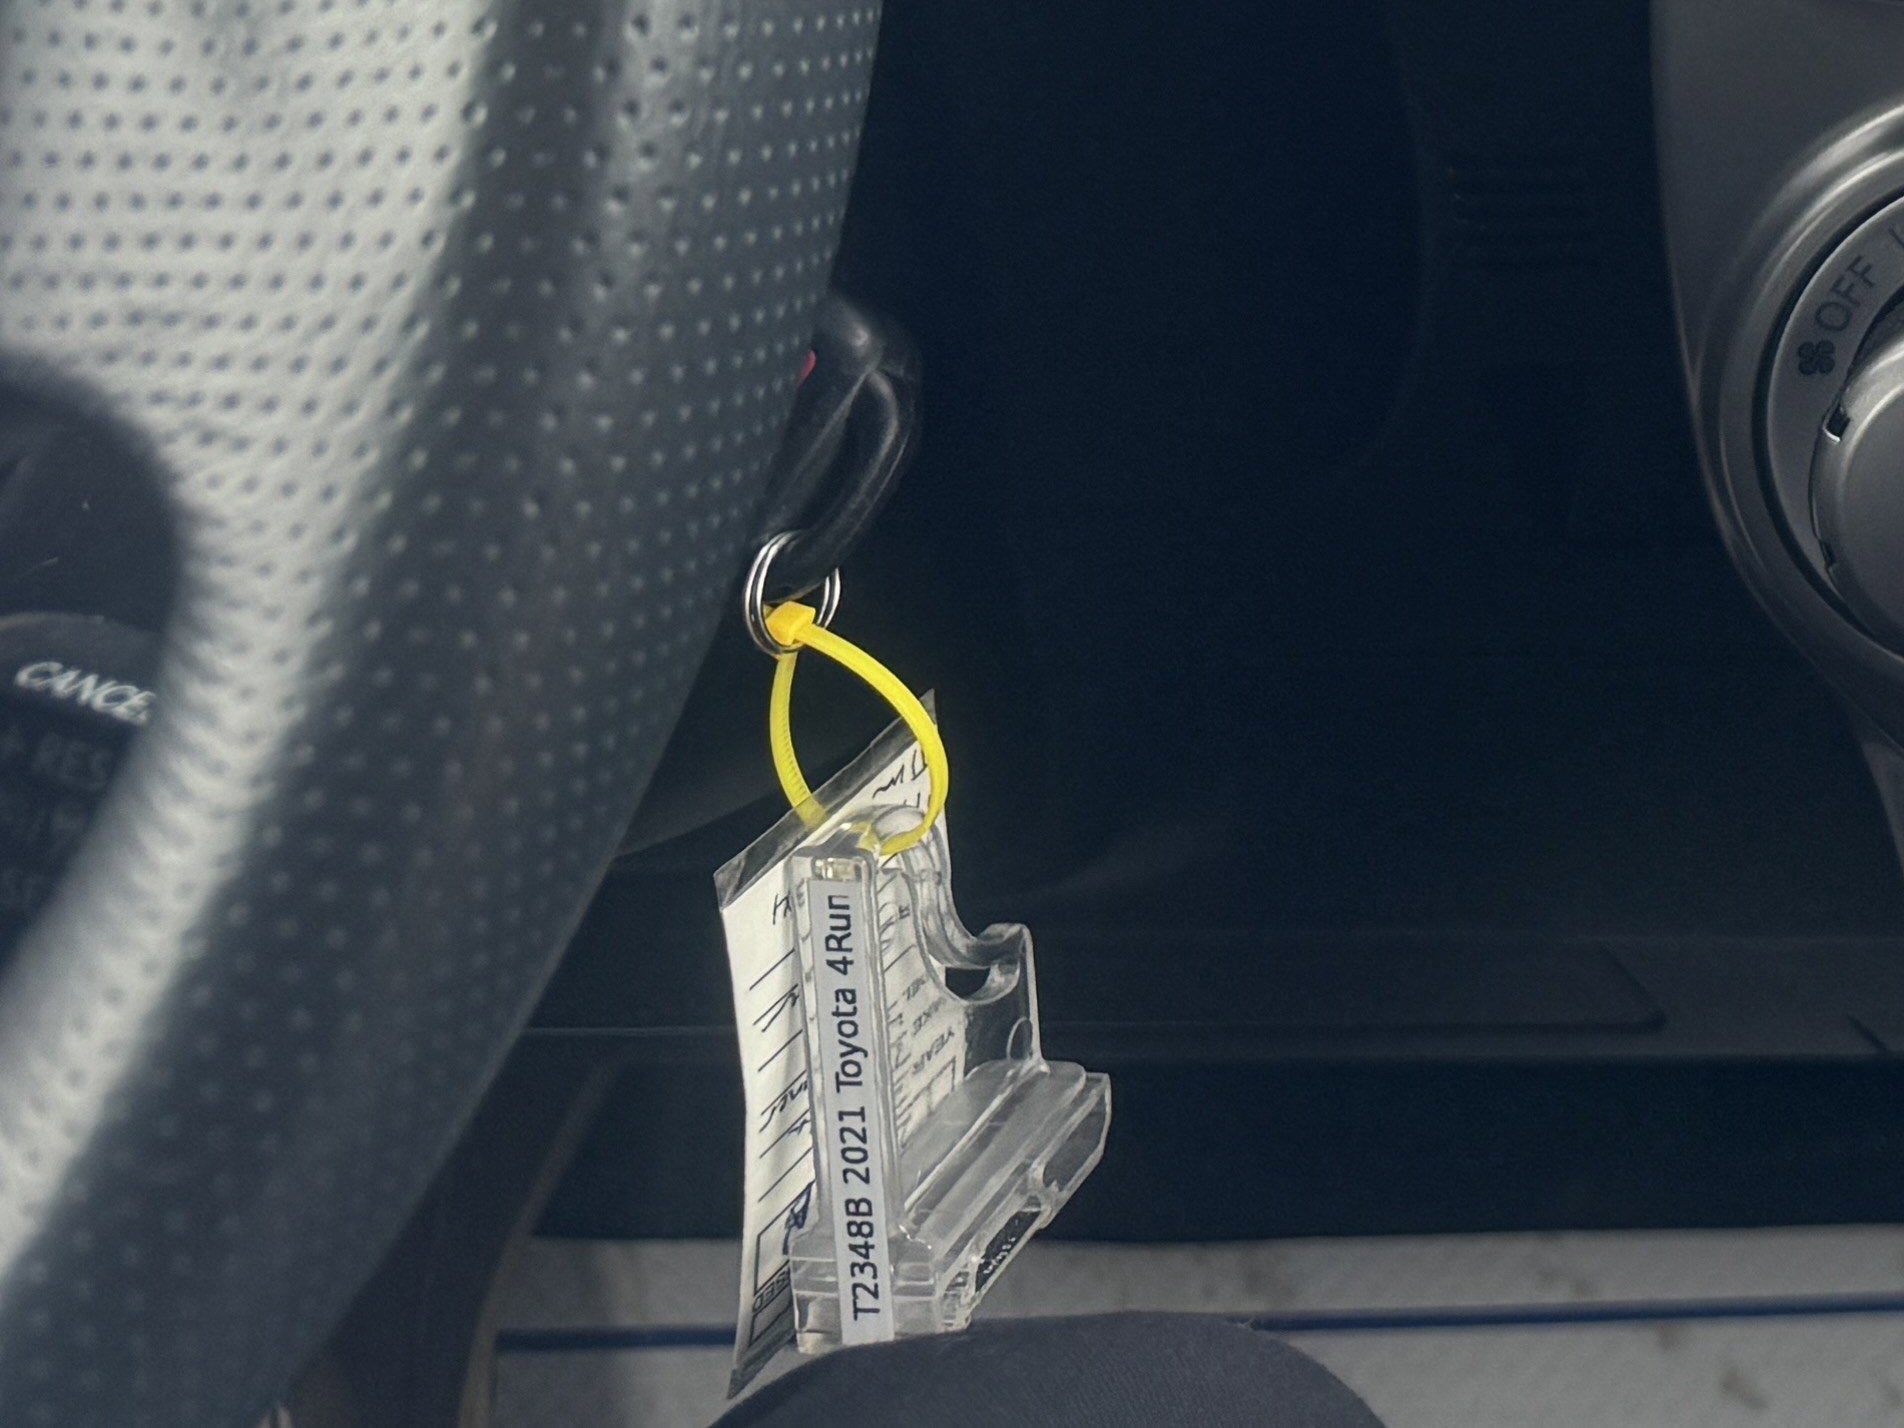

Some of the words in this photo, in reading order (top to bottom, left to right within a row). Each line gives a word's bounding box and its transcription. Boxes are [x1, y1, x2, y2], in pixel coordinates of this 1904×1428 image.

[1814, 254, 1879, 334] OFF
[14, 659, 153, 725] CANCE
[831, 988, 870, 1094] Toyota
[837, 1106, 871, 1186] 2021
[844, 1197, 881, 1321] T2348B
